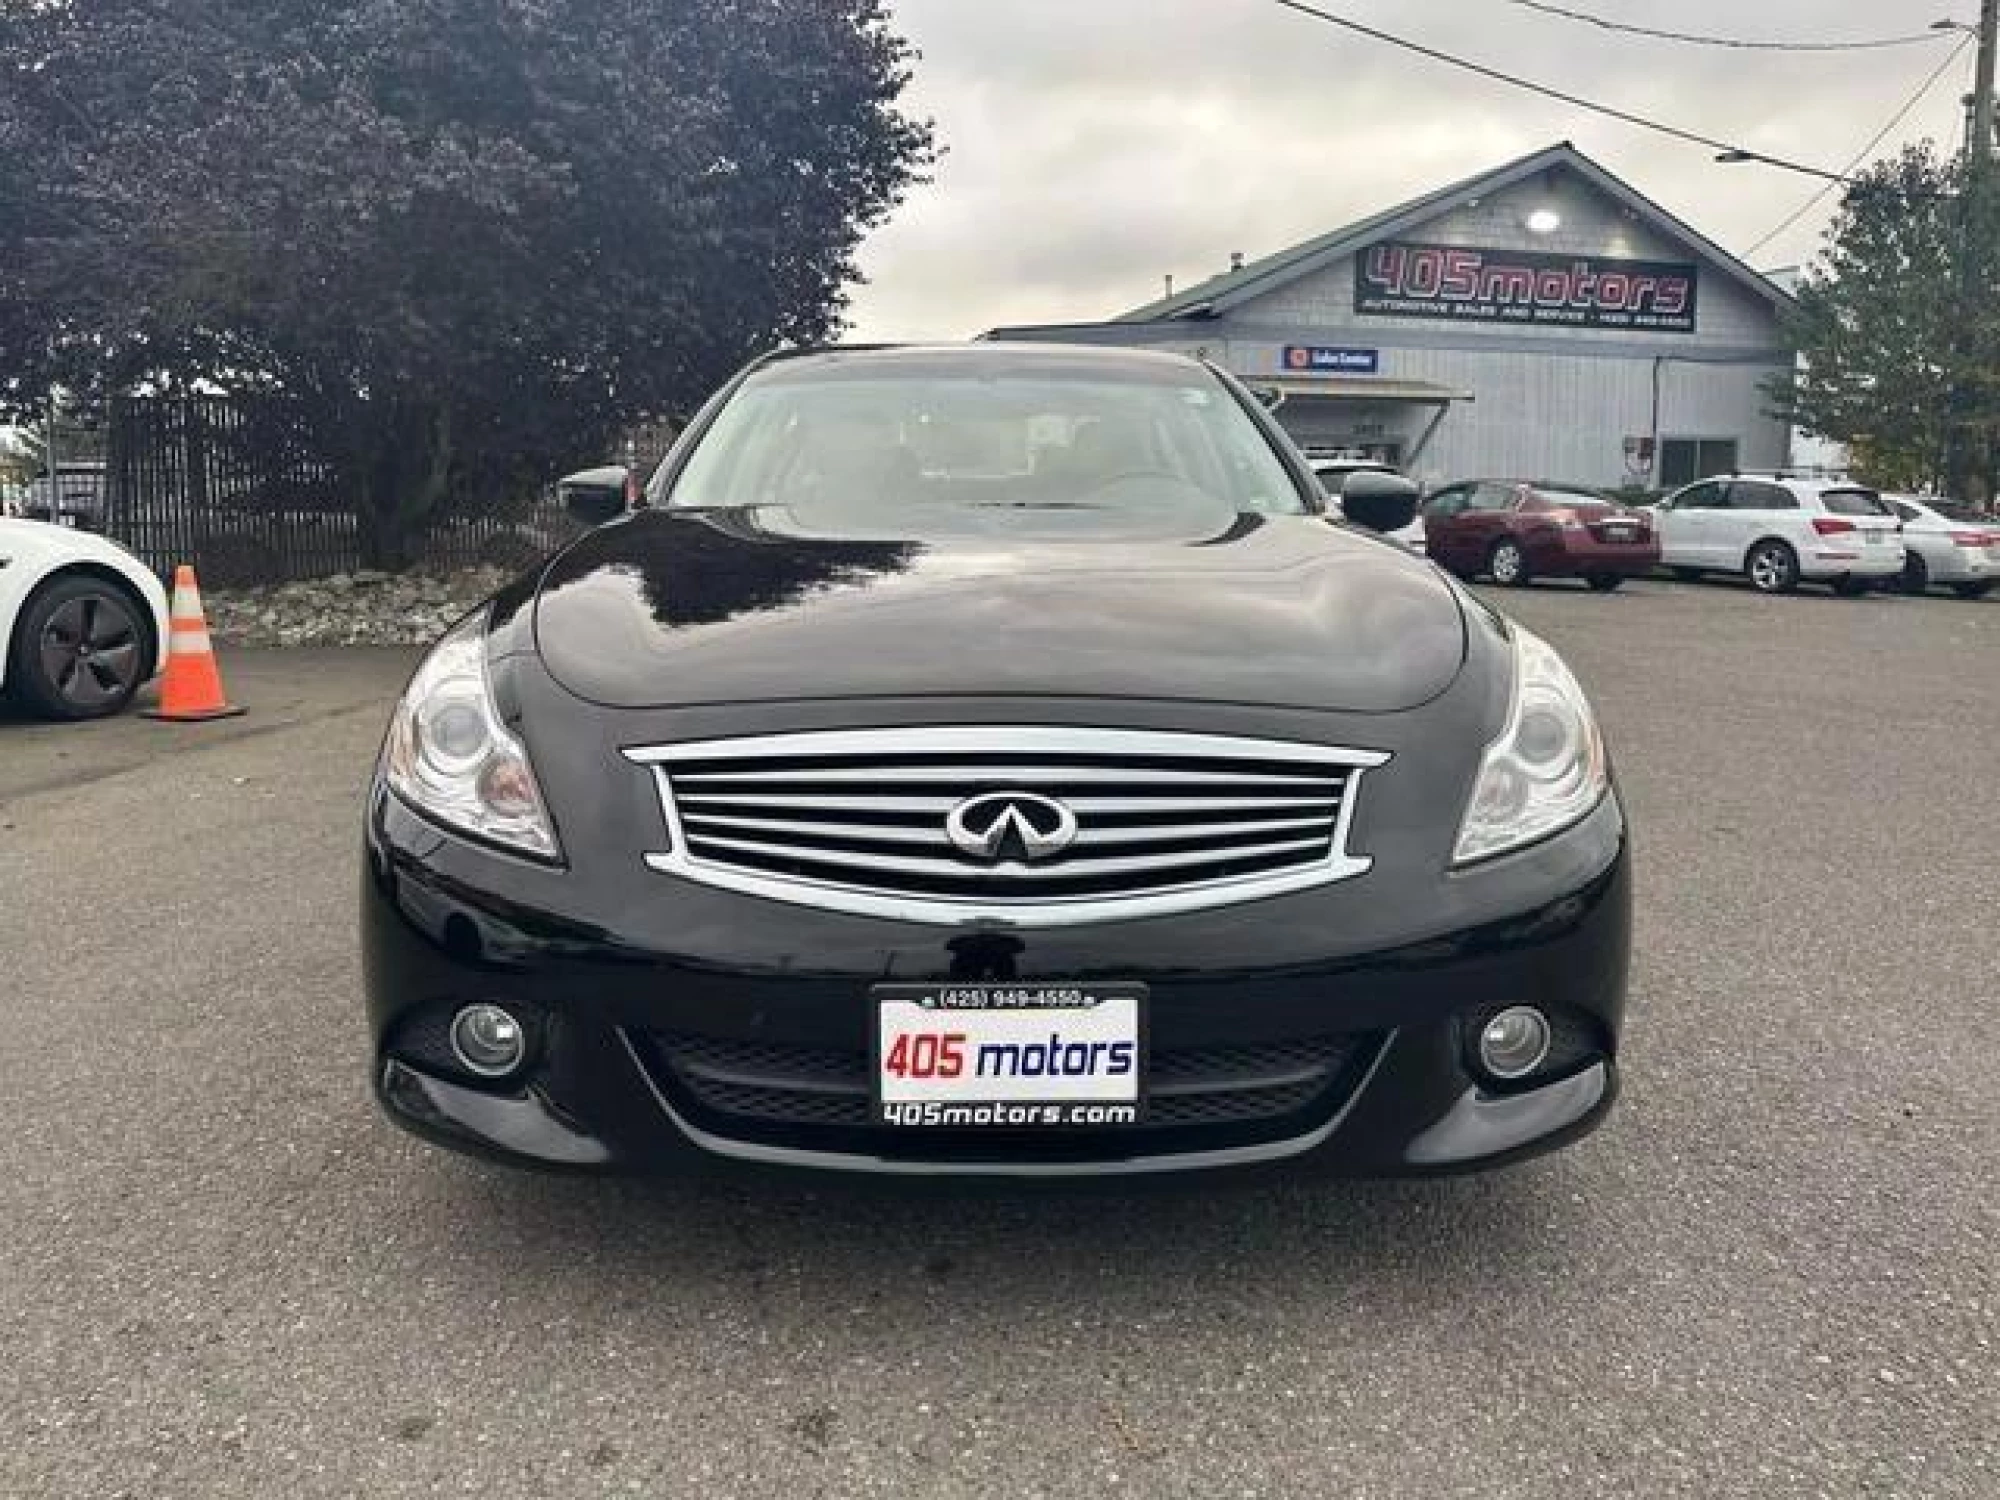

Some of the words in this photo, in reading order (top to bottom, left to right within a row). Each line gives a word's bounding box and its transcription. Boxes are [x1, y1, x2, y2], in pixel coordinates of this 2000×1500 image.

[1368, 248, 1689, 313] 405motors
[886, 1033, 967, 1079] 405
[974, 1033, 1135, 1077] motors
[882, 1102, 1136, 1126] 405motors.com
